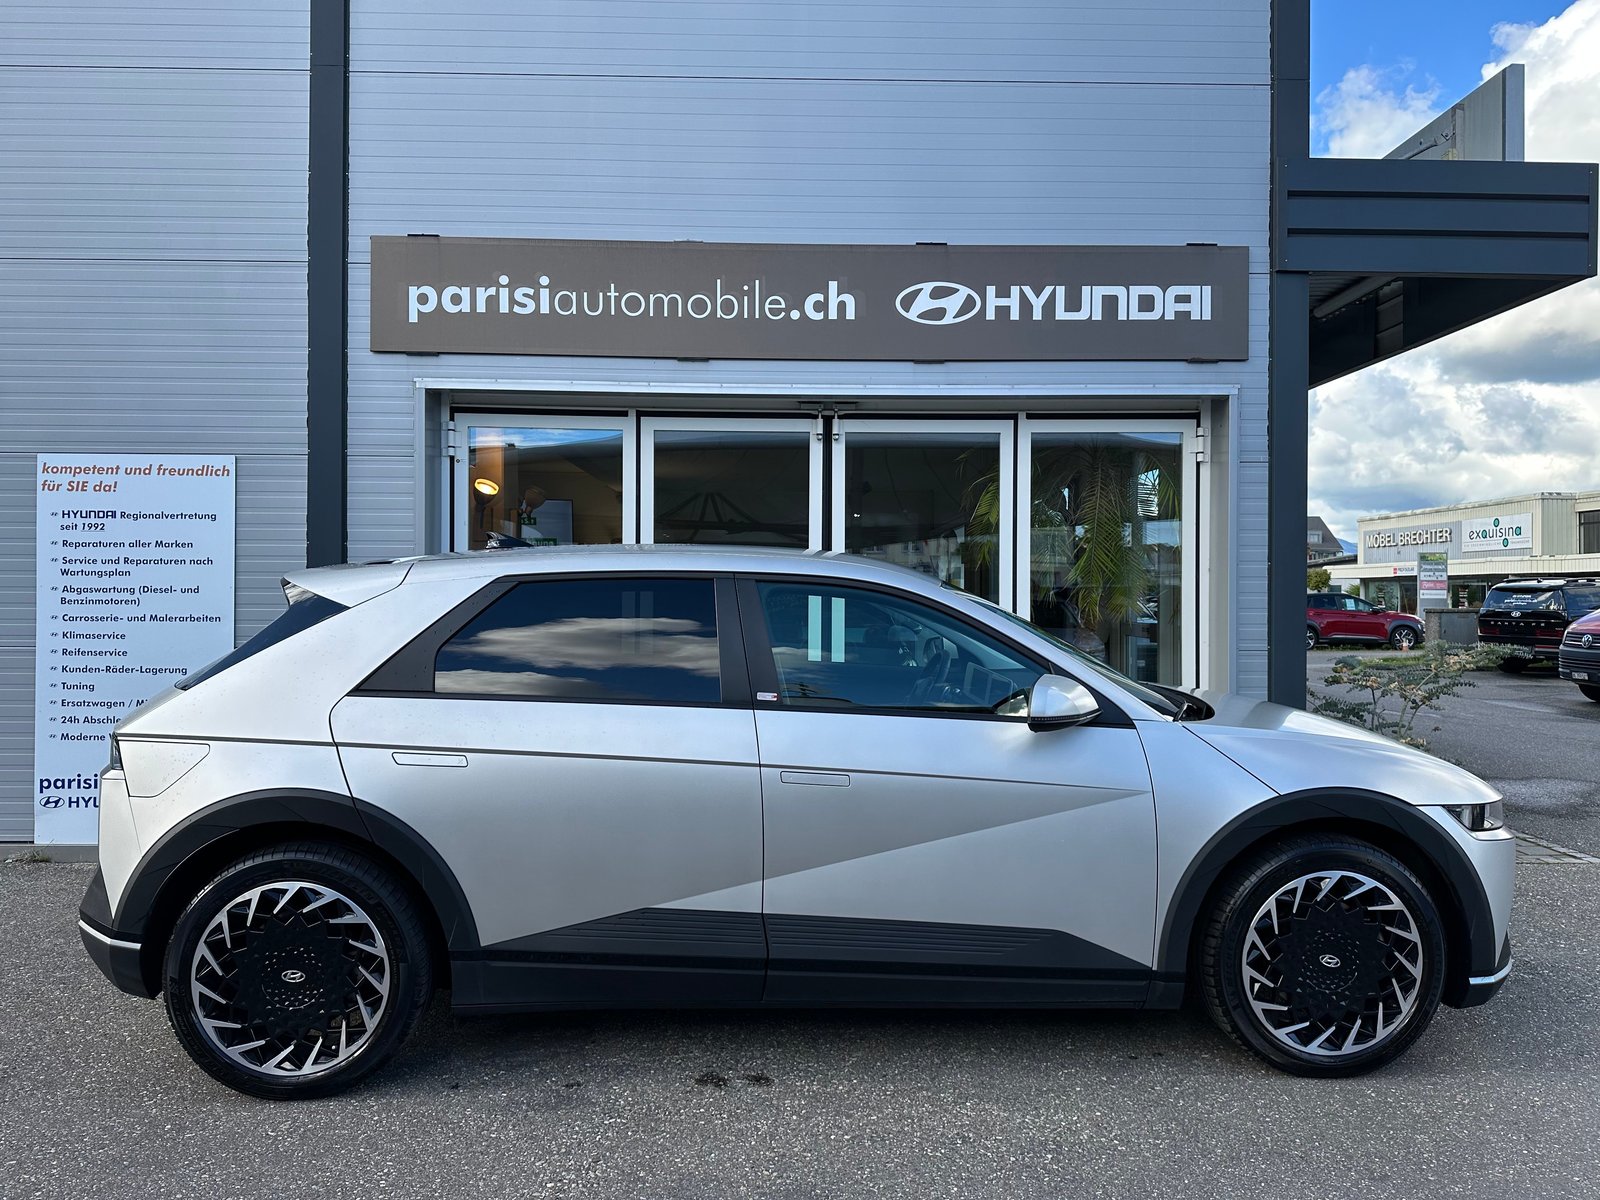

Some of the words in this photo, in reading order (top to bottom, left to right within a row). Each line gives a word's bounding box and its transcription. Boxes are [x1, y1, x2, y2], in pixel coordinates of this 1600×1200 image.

[408, 274, 856, 323] parisiautomobile.ch
[986, 285, 1211, 321] HYUNDAI
[41, 462, 121, 477] kompetent
[124, 464, 153, 476] und
[156, 464, 231, 477] freundlich
[41, 479, 62, 492] für
[66, 481, 89, 492] SIE
[93, 481, 118, 493] da!
[61, 510, 117, 519] HYUNDAI
[120, 511, 218, 522] Regionalvertretung
[59, 522, 78, 531] seit
[81, 522, 106, 532] 1992
[1398, 527, 1452, 547] BRECHTER
[61, 540, 126, 550] Reparaturen
[128, 539, 152, 549] aller
[154, 540, 194, 549] Marken
[61, 556, 98, 566] Service
[100, 557, 120, 566] und
[123, 557, 186, 567] Reparaturen
[189, 557, 214, 566] nach
[60, 568, 131, 578] Wartungsplan
[61, 585, 136, 596] Abgaswartung
[138, 585, 177, 596] (Diesel-
[180, 585, 200, 594] und
[60, 597, 141, 607] Benzinmotoren)
[61, 614, 124, 623] Carrosserie-
[127, 614, 147, 623] und
[149, 614, 222, 623] Malerarbeiten
[62, 631, 127, 640] Klimaservice
[61, 648, 129, 657] Reifenservice
[61, 665, 188, 676] Kunden-Räder-Lagerung
[61, 682, 95, 692] Tuning
[61, 699, 126, 709] Ersatzwagen
[127, 699, 134, 708] /
[135, 699, 149, 707] M
[60, 716, 80, 725] 24h
[60, 733, 106, 742] Moderne
[40, 773, 99, 794] parisi
